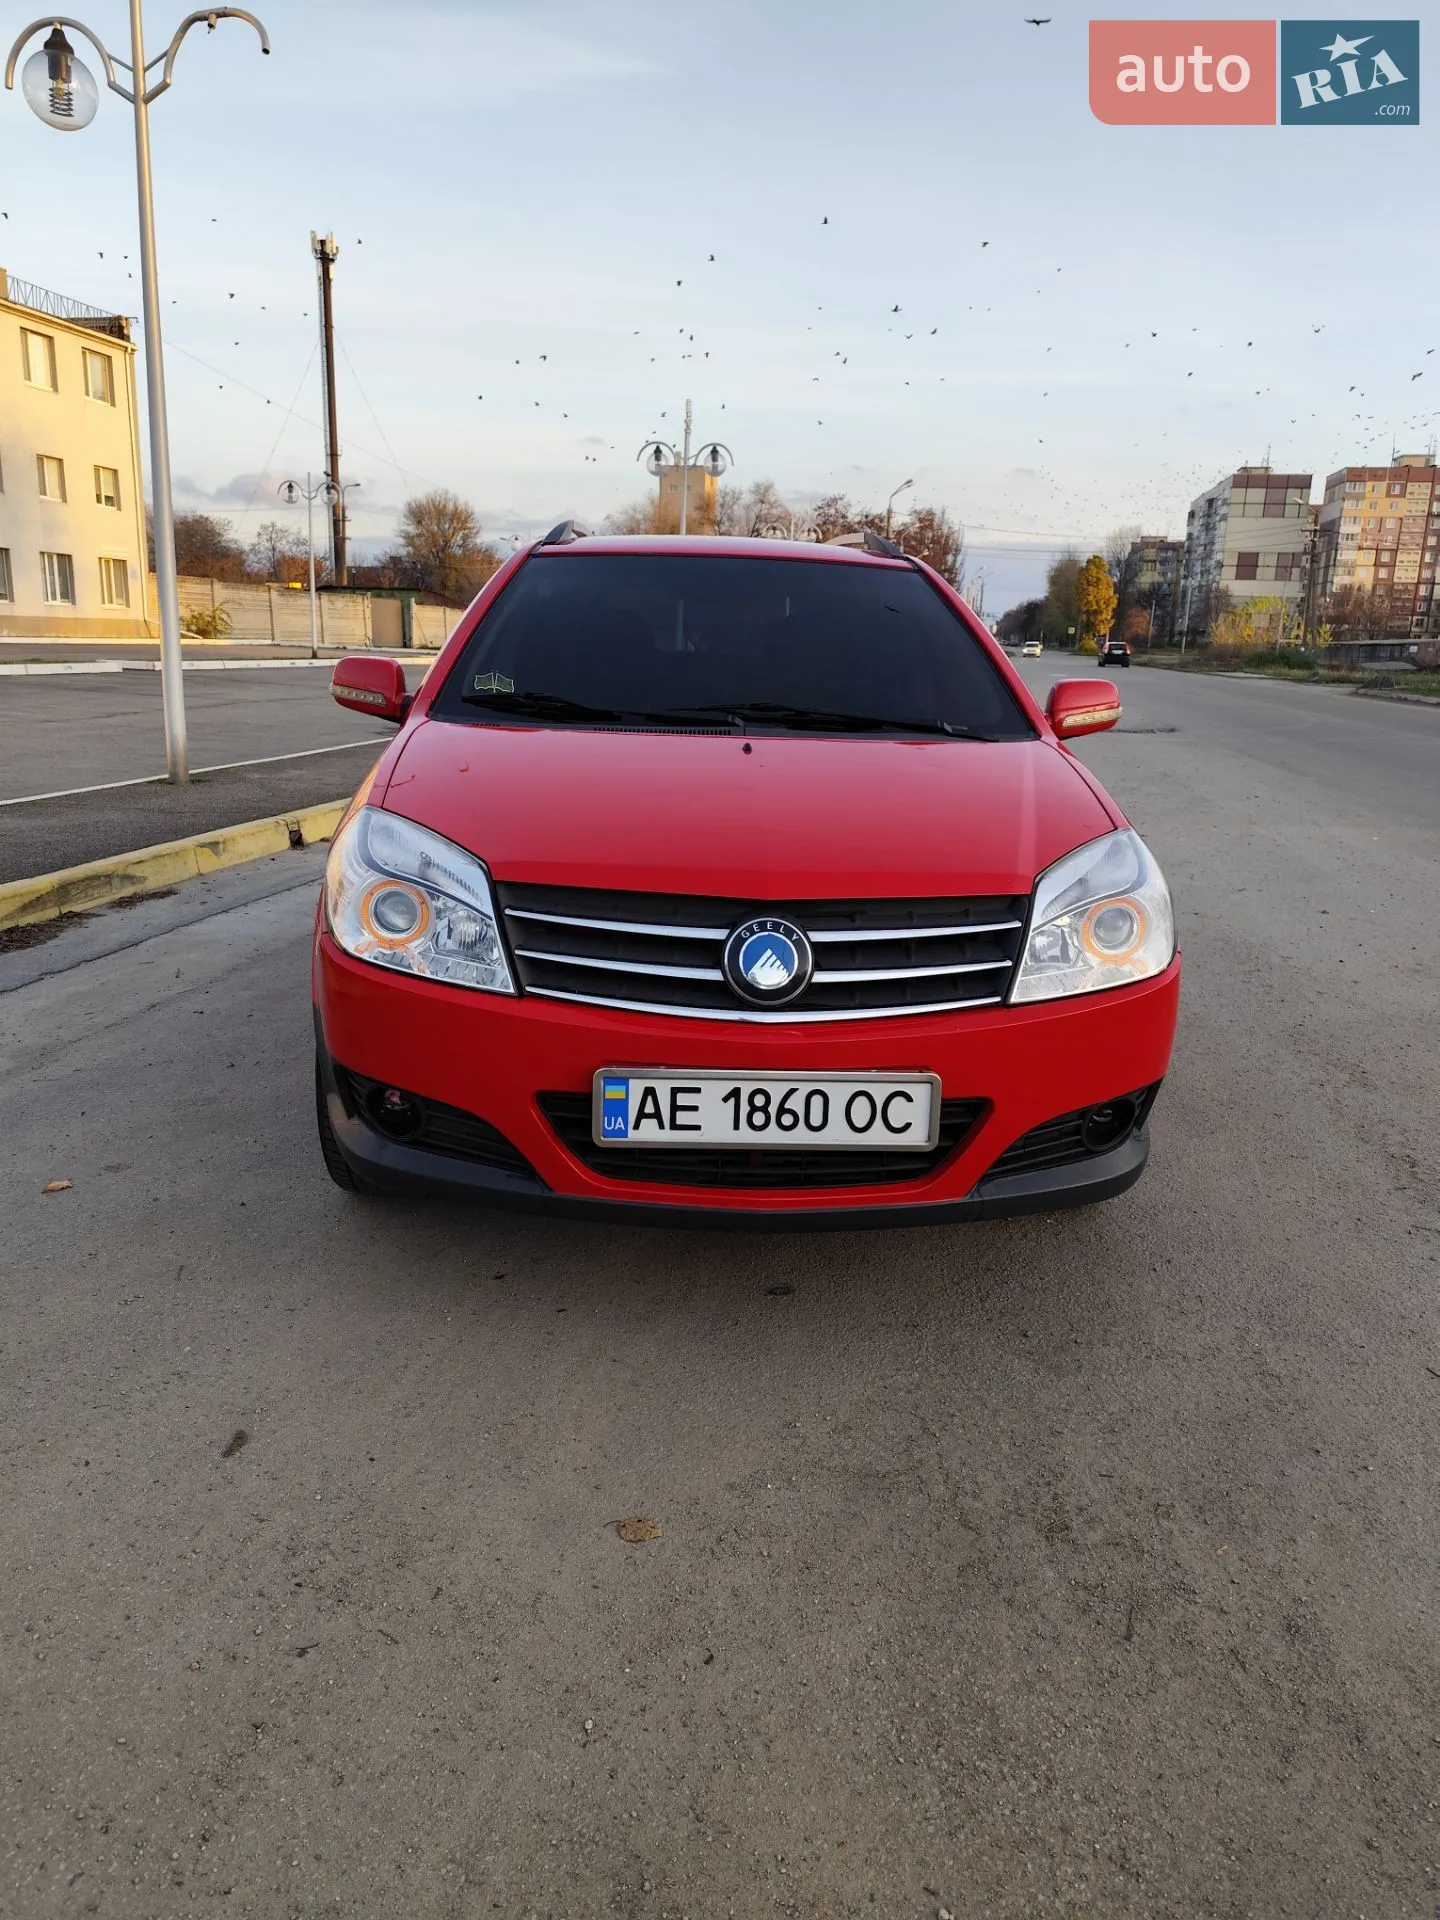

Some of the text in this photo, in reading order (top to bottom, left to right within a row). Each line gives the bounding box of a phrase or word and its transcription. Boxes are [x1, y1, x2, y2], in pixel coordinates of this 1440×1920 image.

[741, 921, 800, 941] GEELY
[632, 1086, 914, 1134] AE 1860 OC
[604, 1117, 625, 1131] UA
